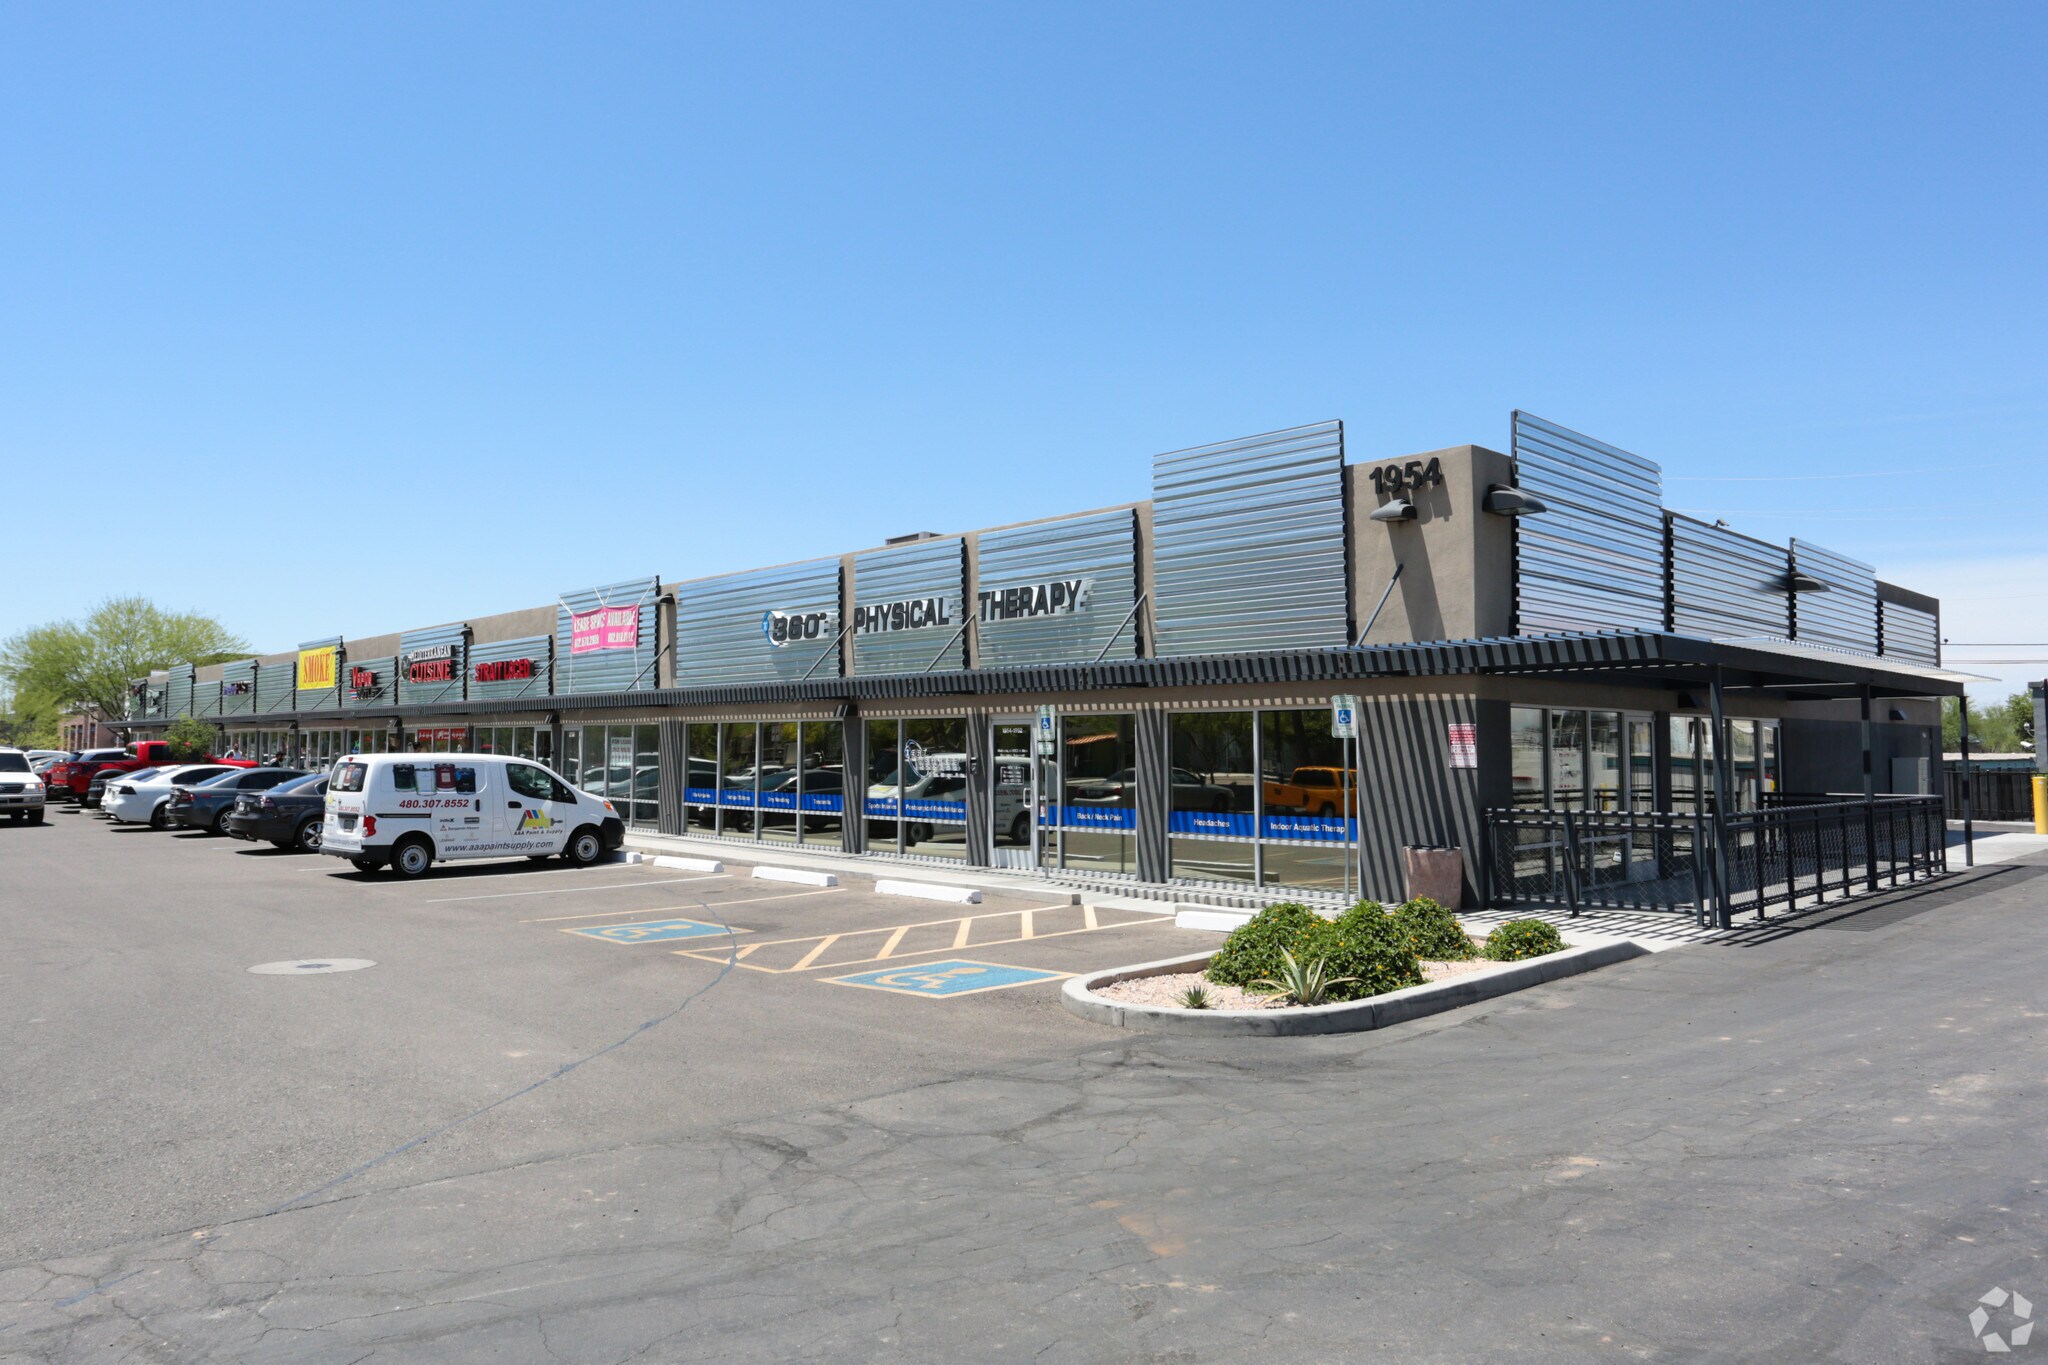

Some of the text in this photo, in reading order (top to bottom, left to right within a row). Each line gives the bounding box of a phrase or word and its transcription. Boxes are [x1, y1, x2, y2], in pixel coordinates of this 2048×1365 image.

[1369, 457, 1443, 494] 1954
[853, 597, 950, 634] PHYSICAL
[979, 579, 1083, 622] THERAPY
[574, 615, 590, 633] LEASE
[606, 610, 636, 627] AVAILABLE
[409, 644, 451, 662] MEDITERRANEAN
[303, 653, 331, 684] SMOKE
[409, 658, 452, 684] CUISINE
[475, 658, 531, 683] STRAIT LACED
[399, 799, 469, 808] 480.307.8552
[868, 802, 881, 810] Sports
[905, 804, 933, 813] Postsurgical
[1077, 812, 1090, 820] Back
[1095, 813, 1109, 821] Neck
[1110, 814, 1123, 822] Pain
[1193, 818, 1230, 828] Headaches
[1270, 822, 1346, 834] Indoor Aquatic Therap
[445, 840, 554, 852] www.aaapaintsupply.com
